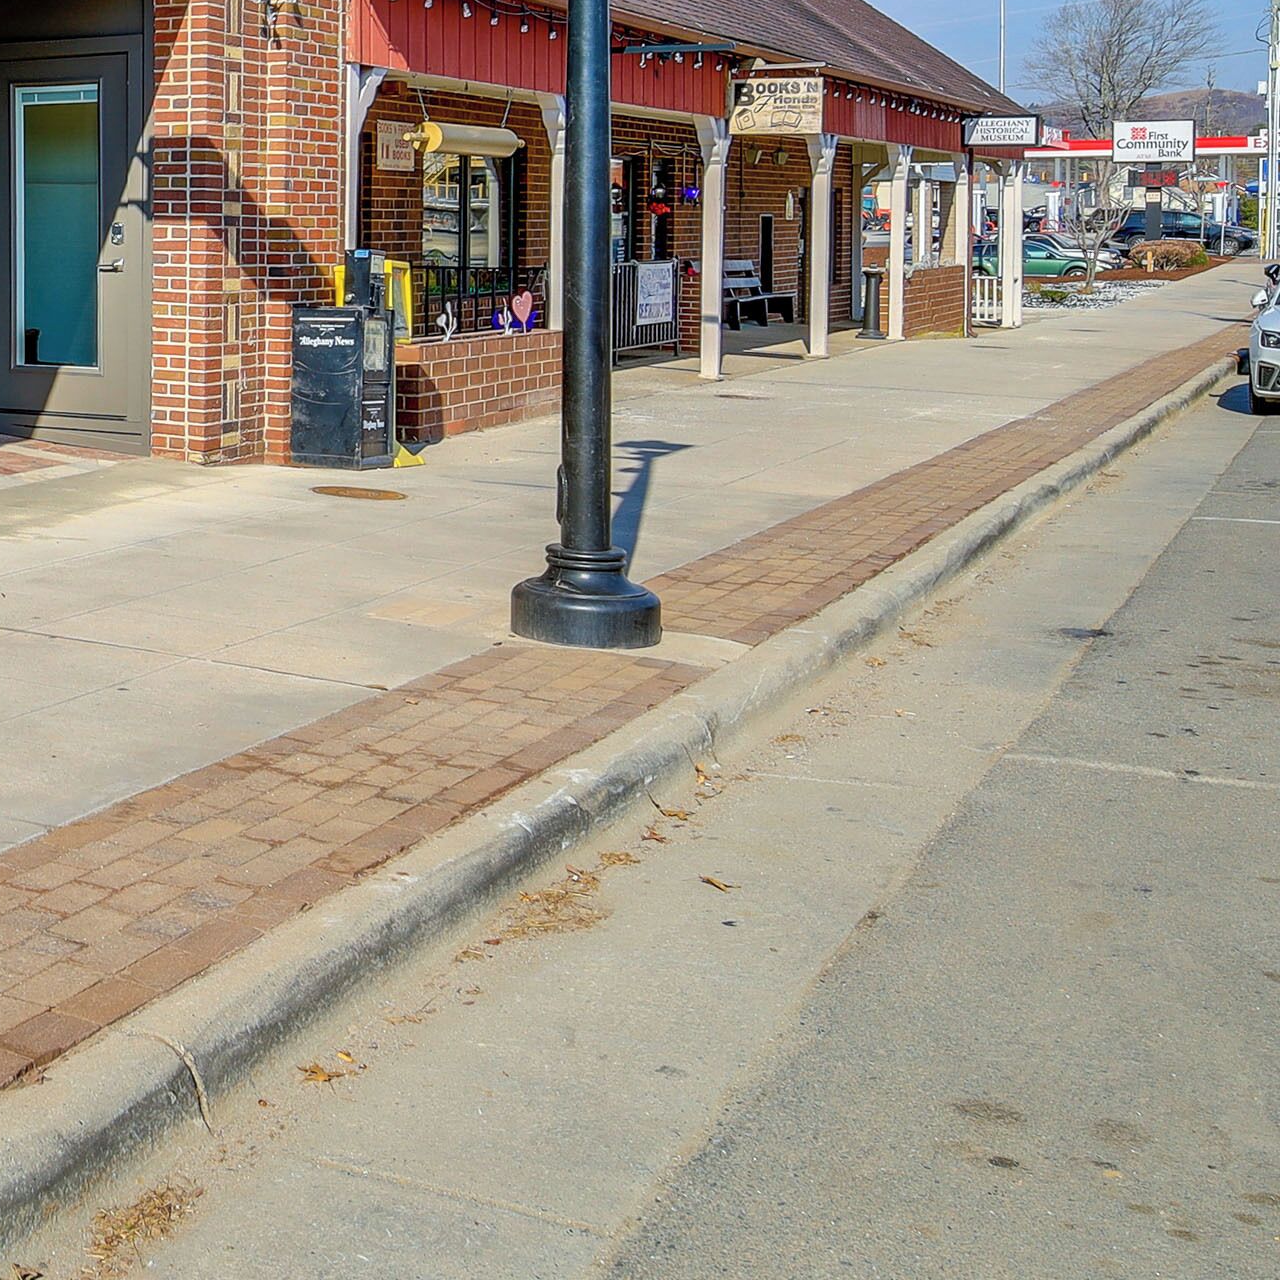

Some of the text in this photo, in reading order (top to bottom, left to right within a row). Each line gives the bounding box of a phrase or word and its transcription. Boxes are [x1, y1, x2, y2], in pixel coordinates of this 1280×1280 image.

[735, 81, 801, 106] BOOKS
[975, 119, 1032, 127] ALLEGHANY
[975, 127, 1030, 135] HISTORICAL
[1148, 131, 1169, 140] First
[980, 134, 1024, 142] MUSEUM
[1116, 138, 1189, 150] Community
[1158, 148, 1182, 158] Bank
[334, 335, 355, 346] News
